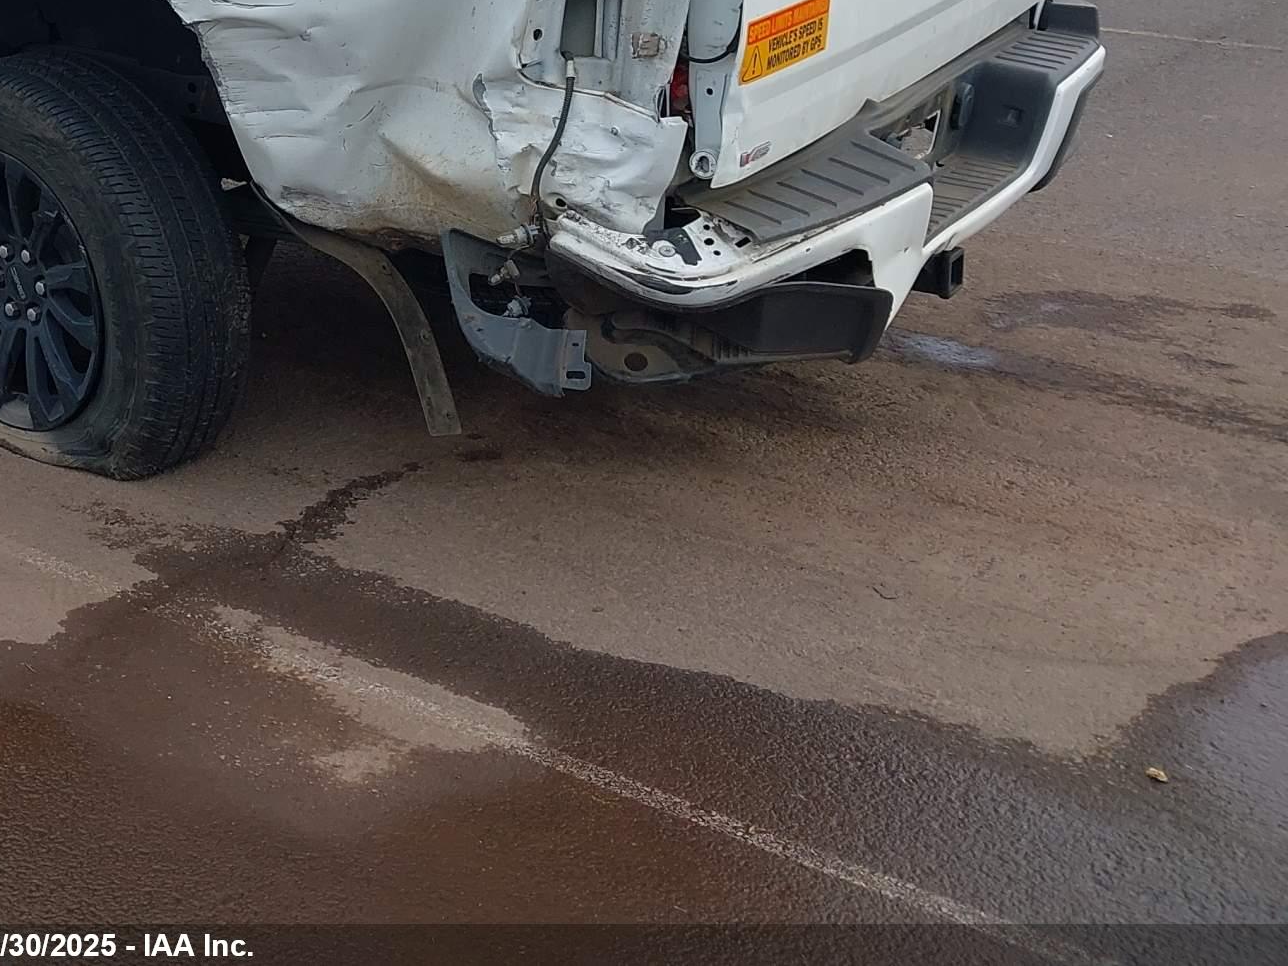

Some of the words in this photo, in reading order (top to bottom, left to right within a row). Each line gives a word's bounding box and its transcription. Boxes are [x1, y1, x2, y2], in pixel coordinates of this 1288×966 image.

[749, 18, 771, 42] SPEED
[768, 28, 798, 53] VEHICLE'S
[799, 20, 817, 41] SPEED
[817, 17, 824, 32] IS
[766, 43, 801, 70] MONITORED
[802, 38, 810, 55] BY
[810, 34, 822, 51] GPS
